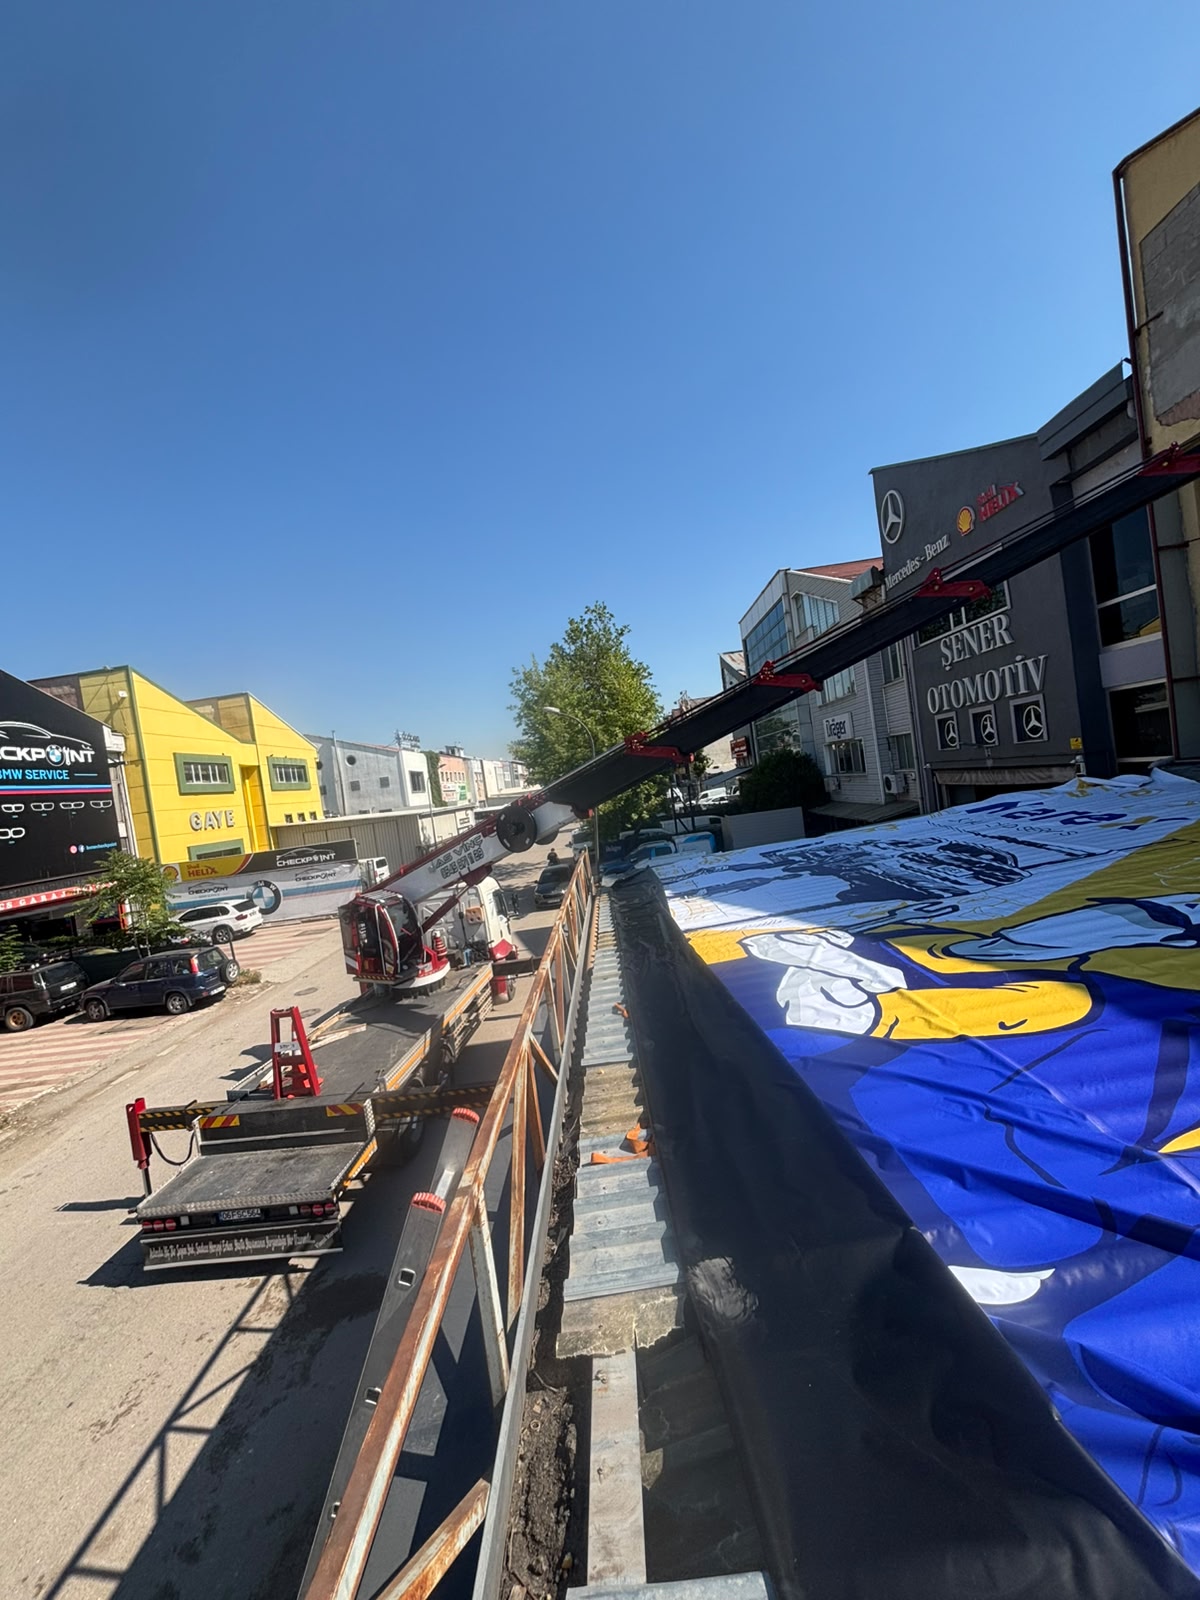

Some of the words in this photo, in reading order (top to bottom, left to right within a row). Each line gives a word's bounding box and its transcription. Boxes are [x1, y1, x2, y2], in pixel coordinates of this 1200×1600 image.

[940, 614, 1014, 671] ŞENER
[927, 655, 1048, 714] OTOMOTİV
[25, 769, 70, 780] SERVICE
[189, 810, 235, 831] GAYE
[188, 865, 218, 878] HELIX
